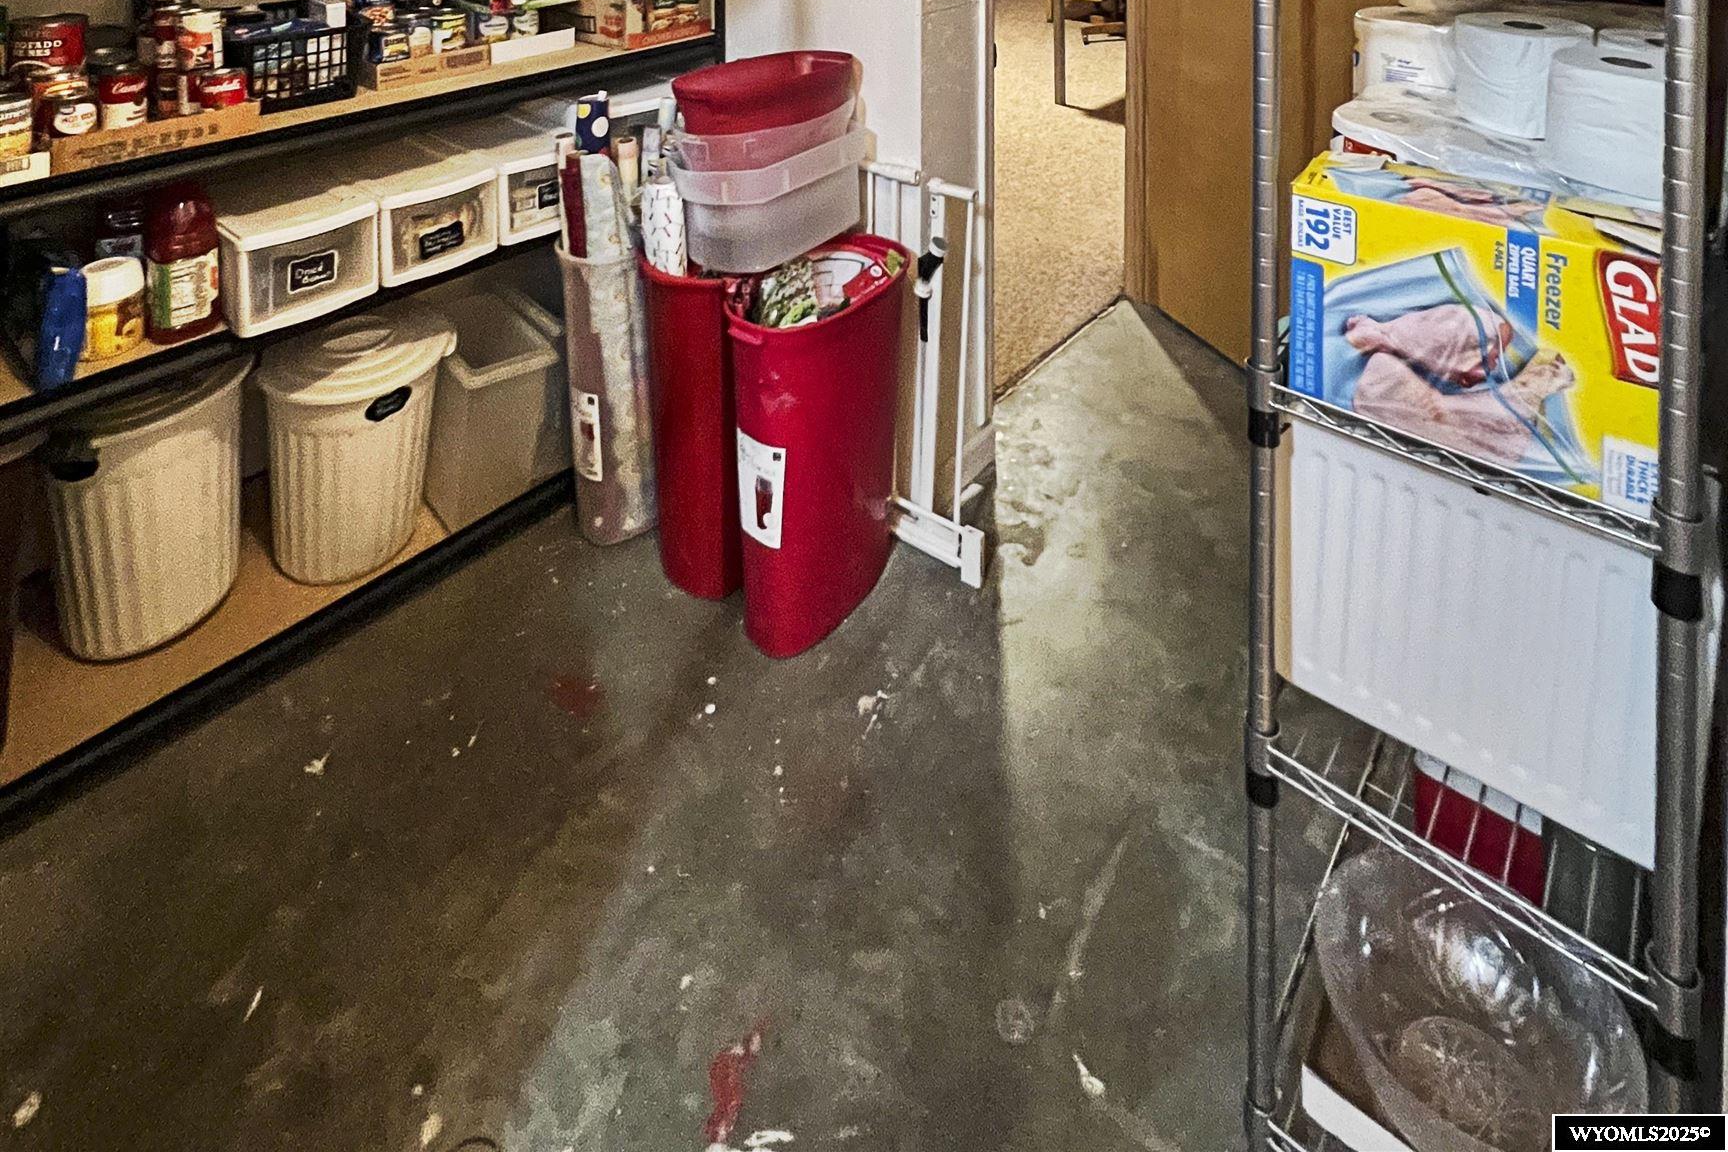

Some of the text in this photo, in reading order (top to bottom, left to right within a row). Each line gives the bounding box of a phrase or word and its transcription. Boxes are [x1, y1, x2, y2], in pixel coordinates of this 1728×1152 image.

[1305, 207, 1331, 251] 192
[1332, 208, 1342, 240] VALUE
[1343, 209, 1353, 236] BEST
[1507, 242, 1521, 299] ZIPPER BAGS
[1520, 246, 1537, 290] QUART
[1545, 252, 1569, 331] Freezer
[1605, 259, 1661, 383] GLAD
[1625, 454, 1637, 500] DURABLE
